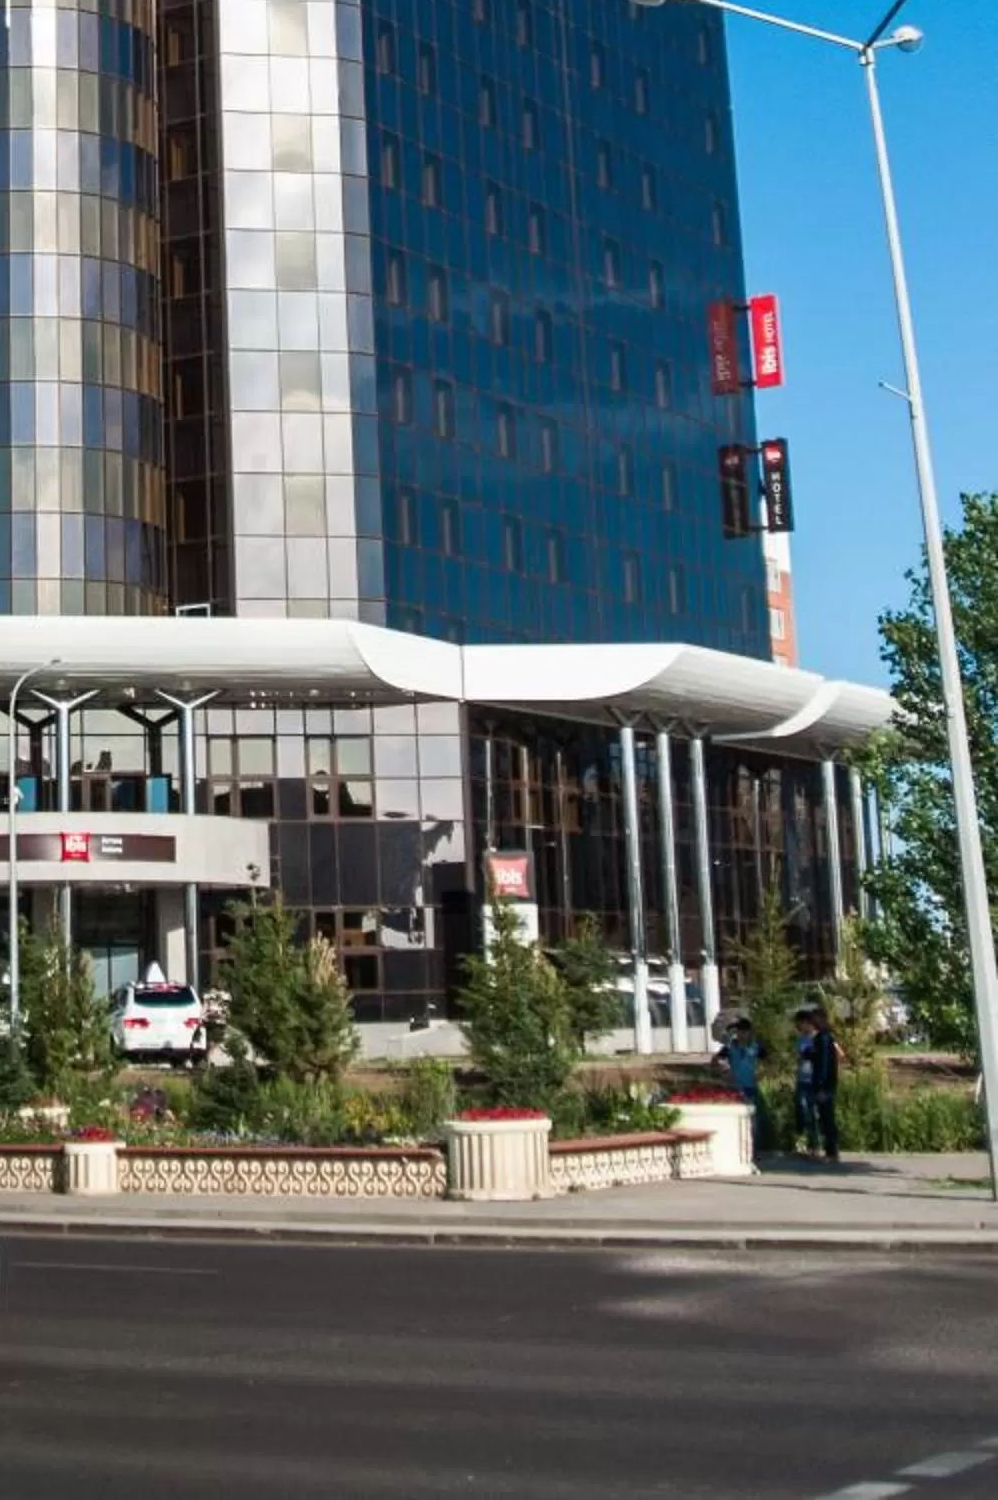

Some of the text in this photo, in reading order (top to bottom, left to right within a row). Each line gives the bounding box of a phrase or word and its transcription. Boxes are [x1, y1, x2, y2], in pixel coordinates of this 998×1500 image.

[760, 346, 777, 375] ibis
[771, 472, 783, 525] HOTEL
[496, 867, 522, 885] ibis
